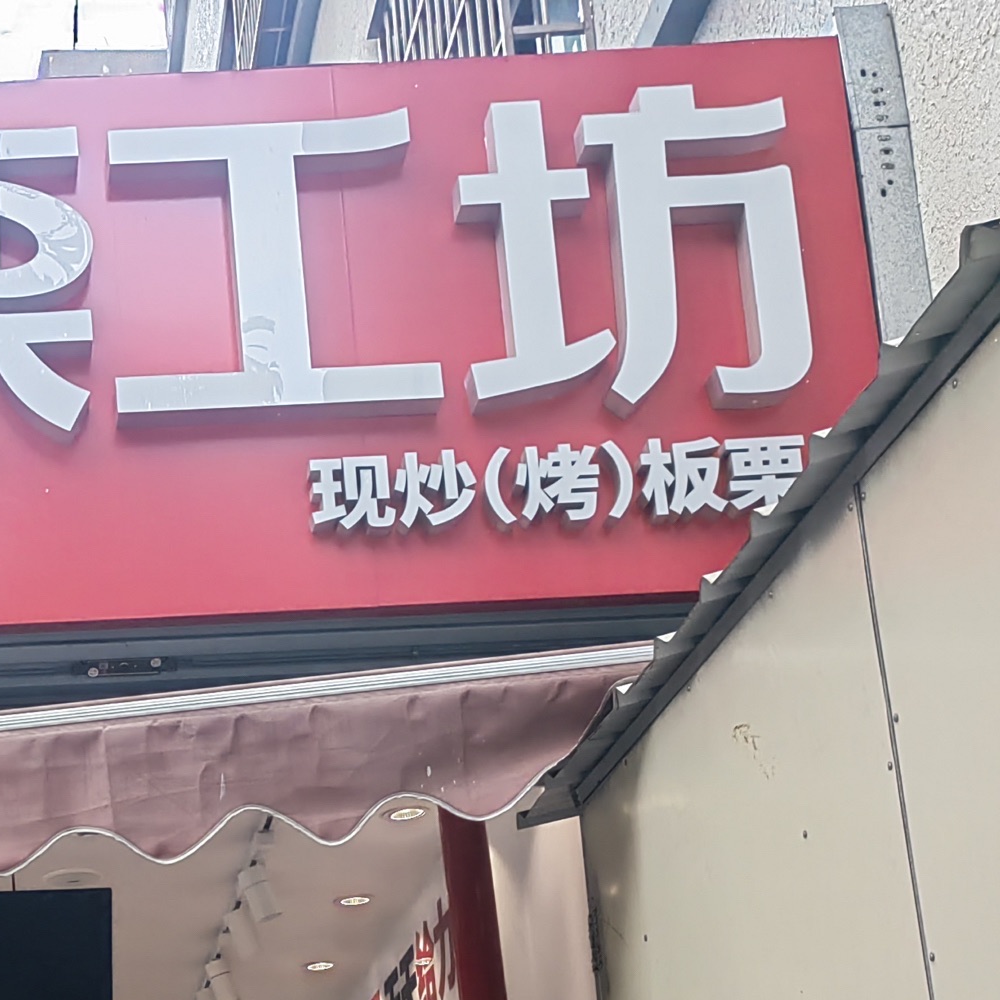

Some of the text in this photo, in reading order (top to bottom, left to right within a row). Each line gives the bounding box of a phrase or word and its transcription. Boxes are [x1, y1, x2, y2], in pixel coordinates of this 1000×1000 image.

[308, 434, 805, 529] 现炒(烤)板栗
